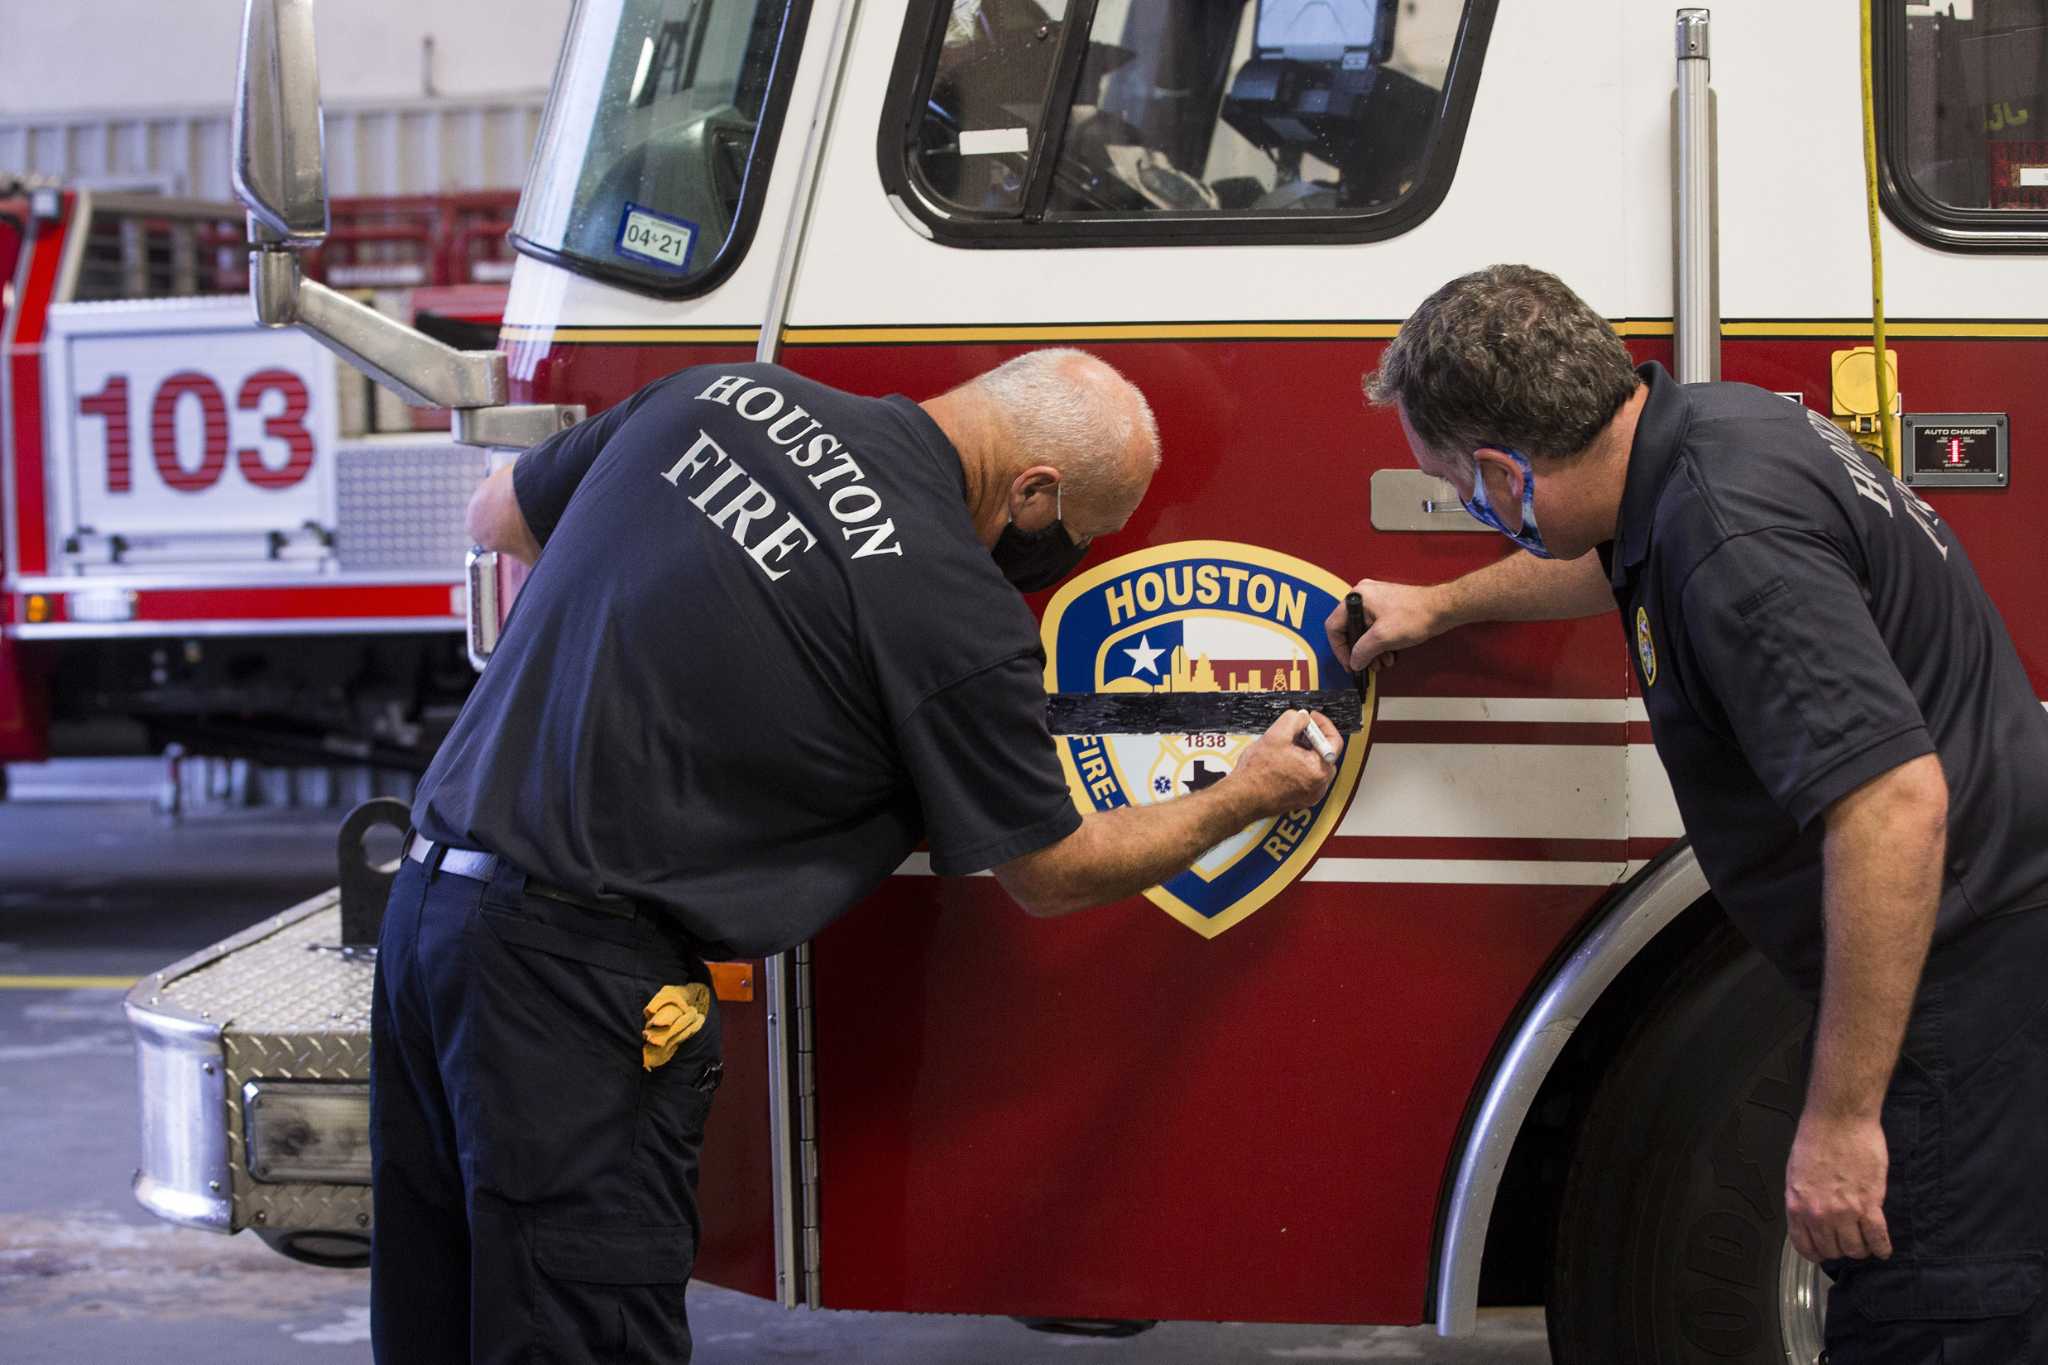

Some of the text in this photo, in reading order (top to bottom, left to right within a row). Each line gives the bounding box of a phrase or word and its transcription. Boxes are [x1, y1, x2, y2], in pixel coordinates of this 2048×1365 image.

[627, 224, 650, 247] 04
[659, 234, 682, 257] 21
[80, 369, 316, 493] 103
[1924, 428, 1988, 436] AUTO CHARGE
[694, 375, 903, 560] HOUSTON
[660, 428, 818, 582] FIRE
[1104, 564, 1308, 630] HOUSTON
[1184, 734, 1226, 748] 1838
[1263, 808, 1312, 862] RES
